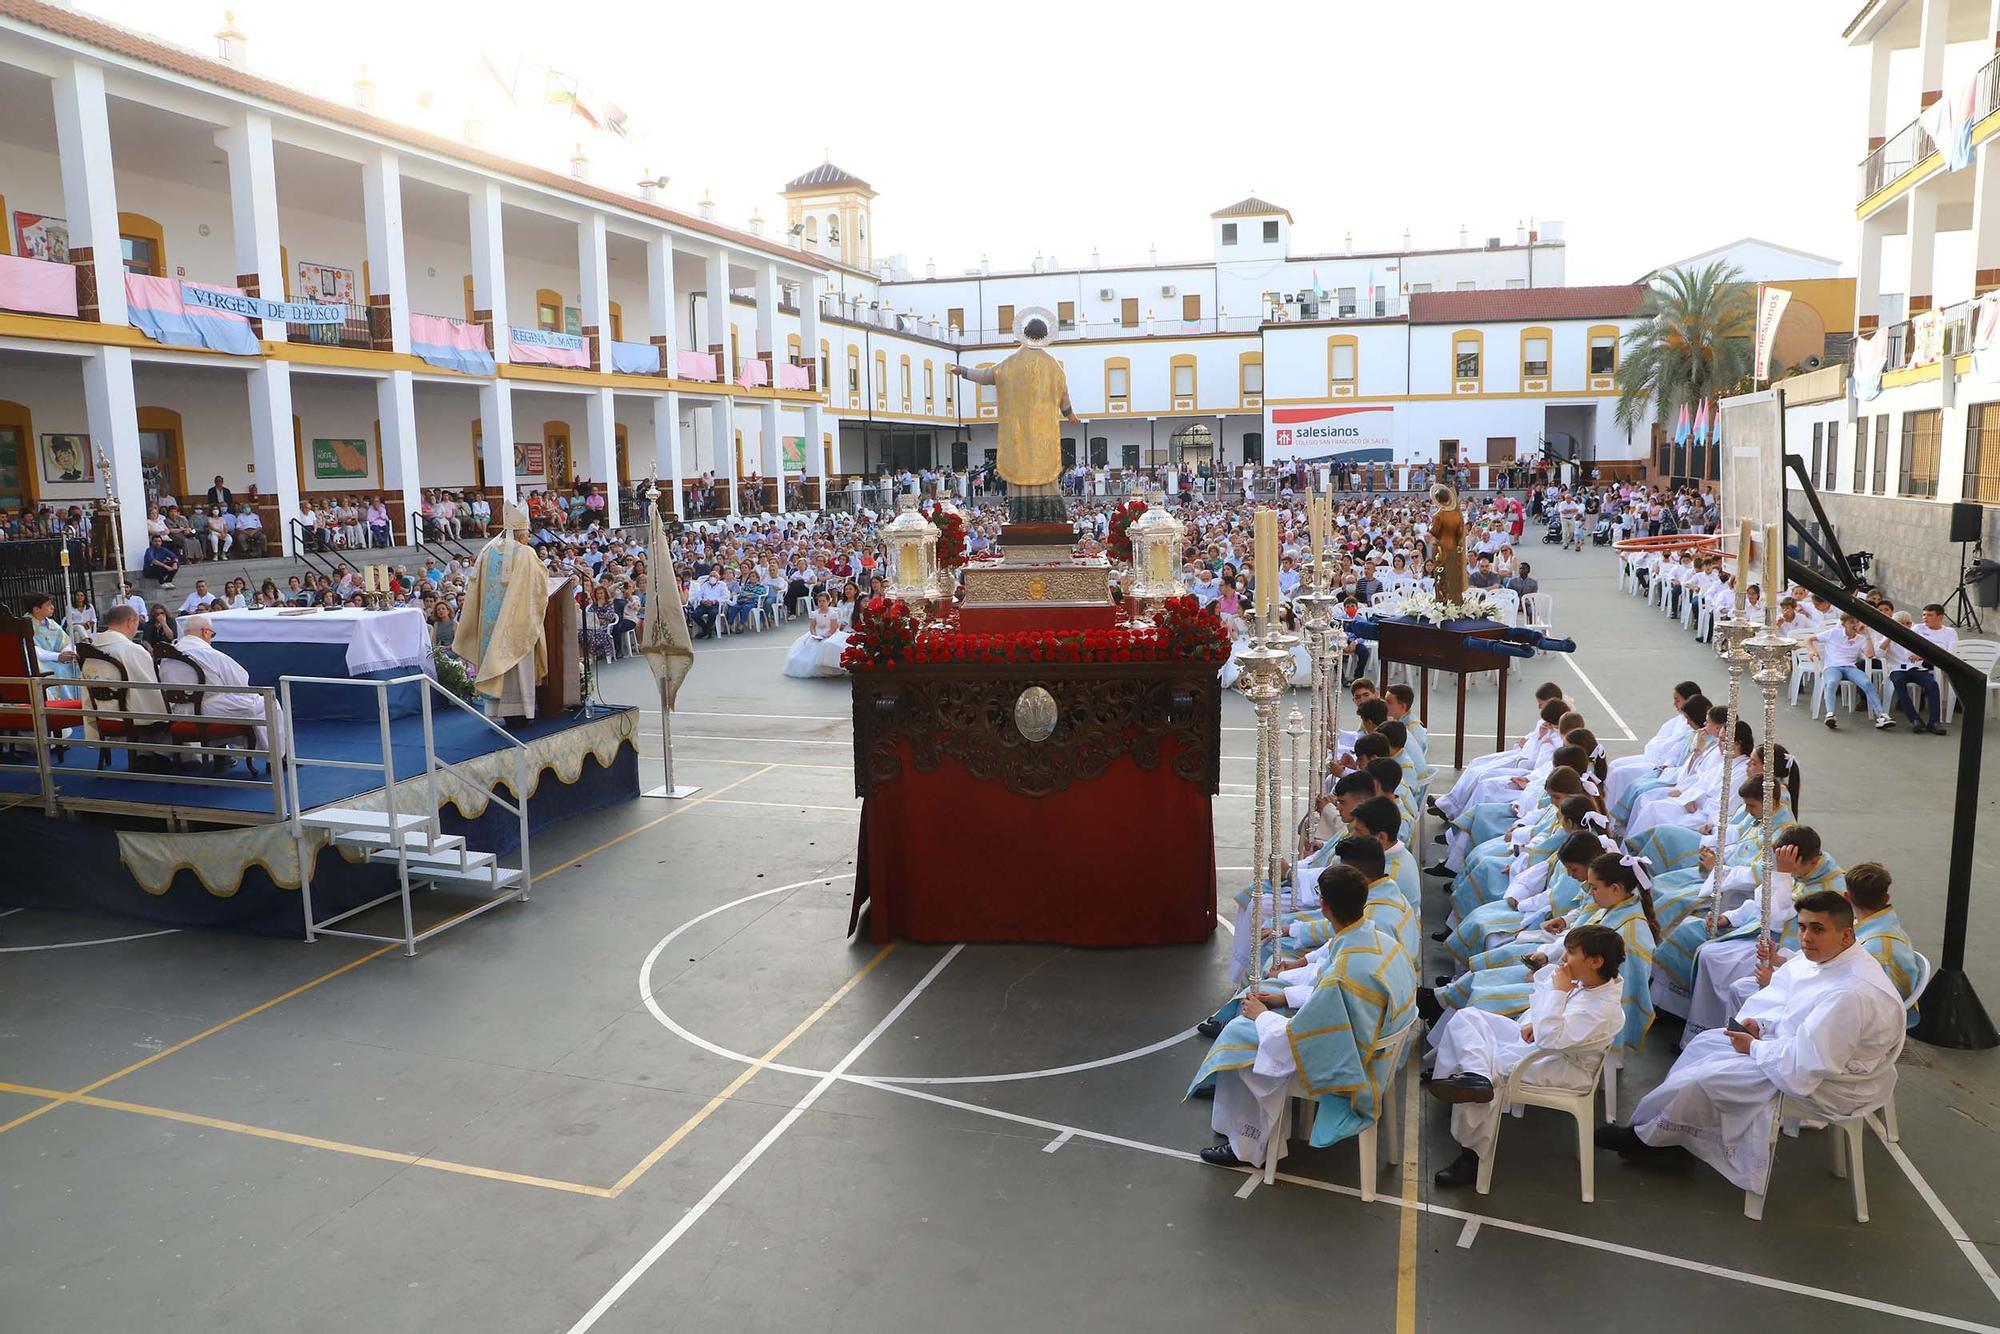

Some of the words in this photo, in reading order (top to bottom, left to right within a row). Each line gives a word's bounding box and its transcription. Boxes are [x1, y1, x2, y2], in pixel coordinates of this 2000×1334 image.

[192, 289, 258, 315] VIRGEN
[268, 303, 286, 319] DE
[512, 329, 548, 345] REGINA
[557, 336, 584, 351] MATER
[1296, 426, 1359, 438] salesianos
